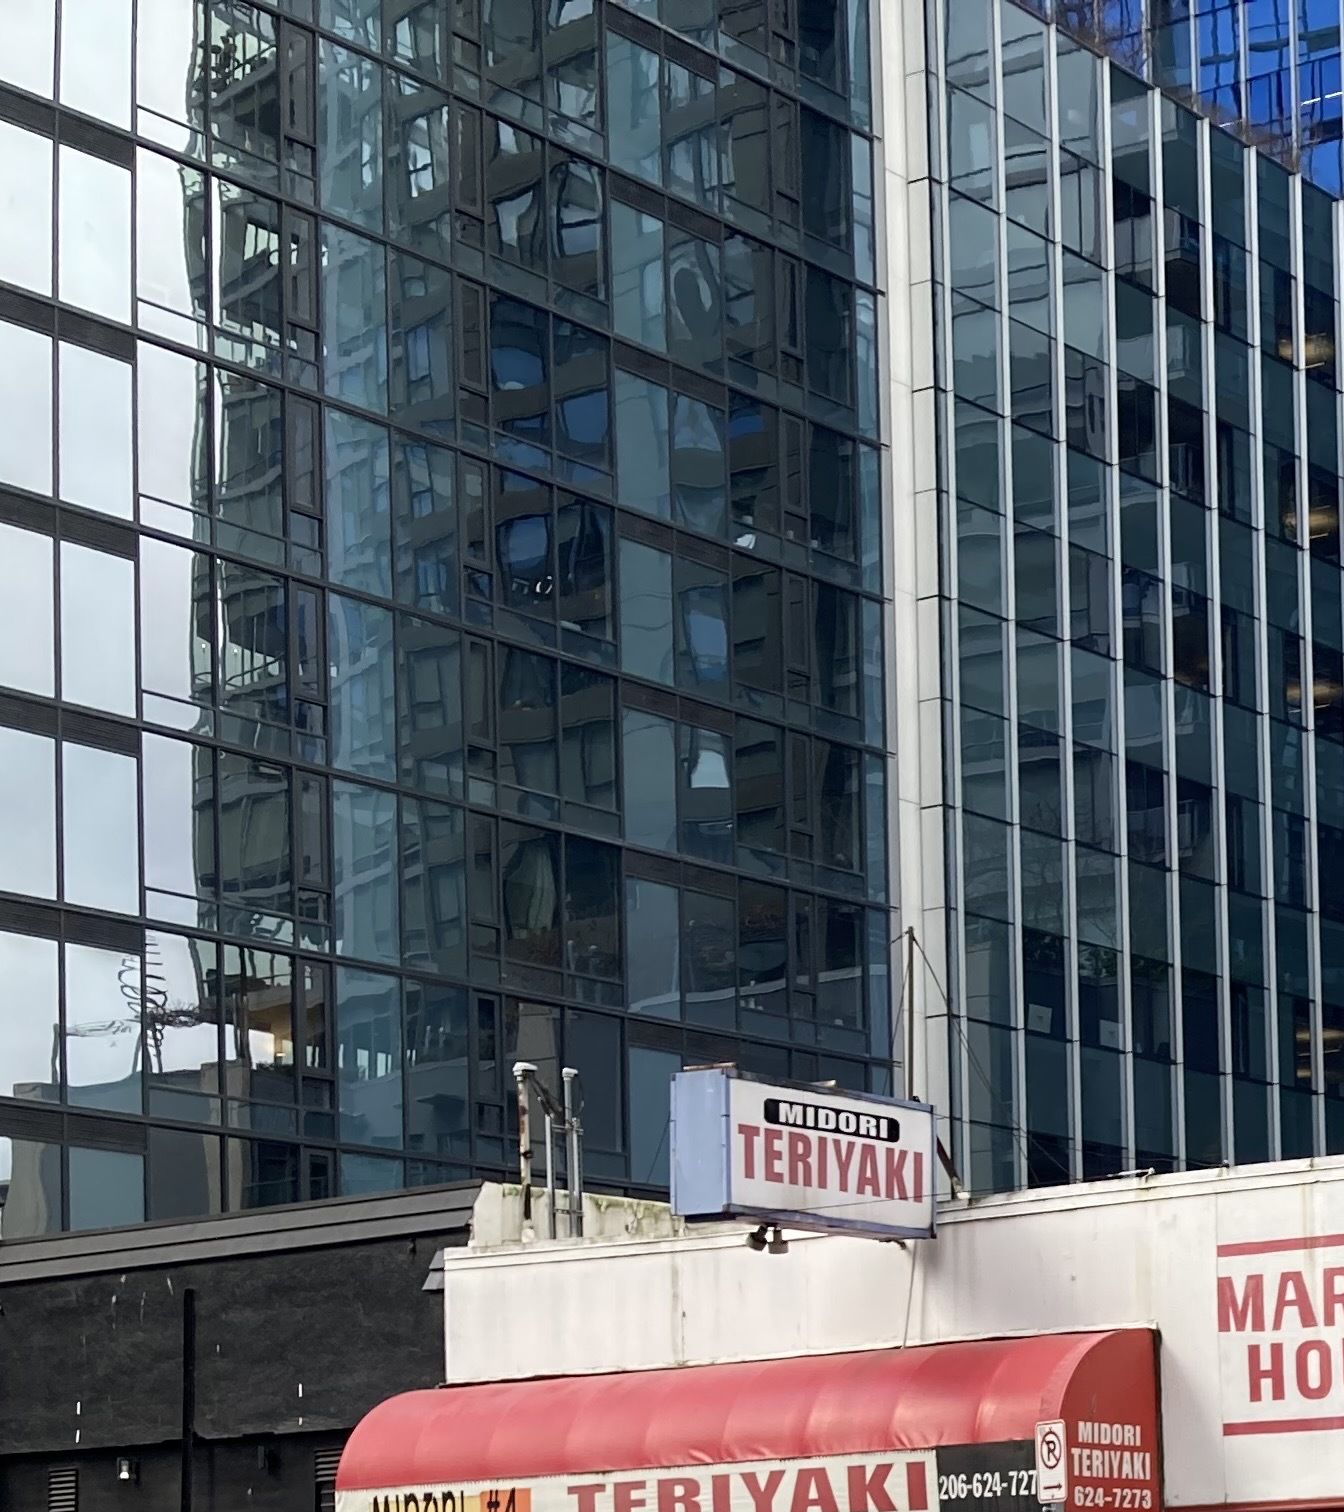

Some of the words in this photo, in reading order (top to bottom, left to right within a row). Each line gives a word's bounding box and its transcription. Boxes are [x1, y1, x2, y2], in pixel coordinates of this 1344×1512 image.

[779, 1102, 889, 1139] MIDORI
[737, 1124, 923, 1203] TERIYAKI
[1077, 1421, 1142, 1447] MIDORI
[1071, 1447, 1152, 1481] TERIYAKI
[938, 1469, 1037, 1502] 206-624-727
[1074, 1486, 1152, 1510] 624-7273
